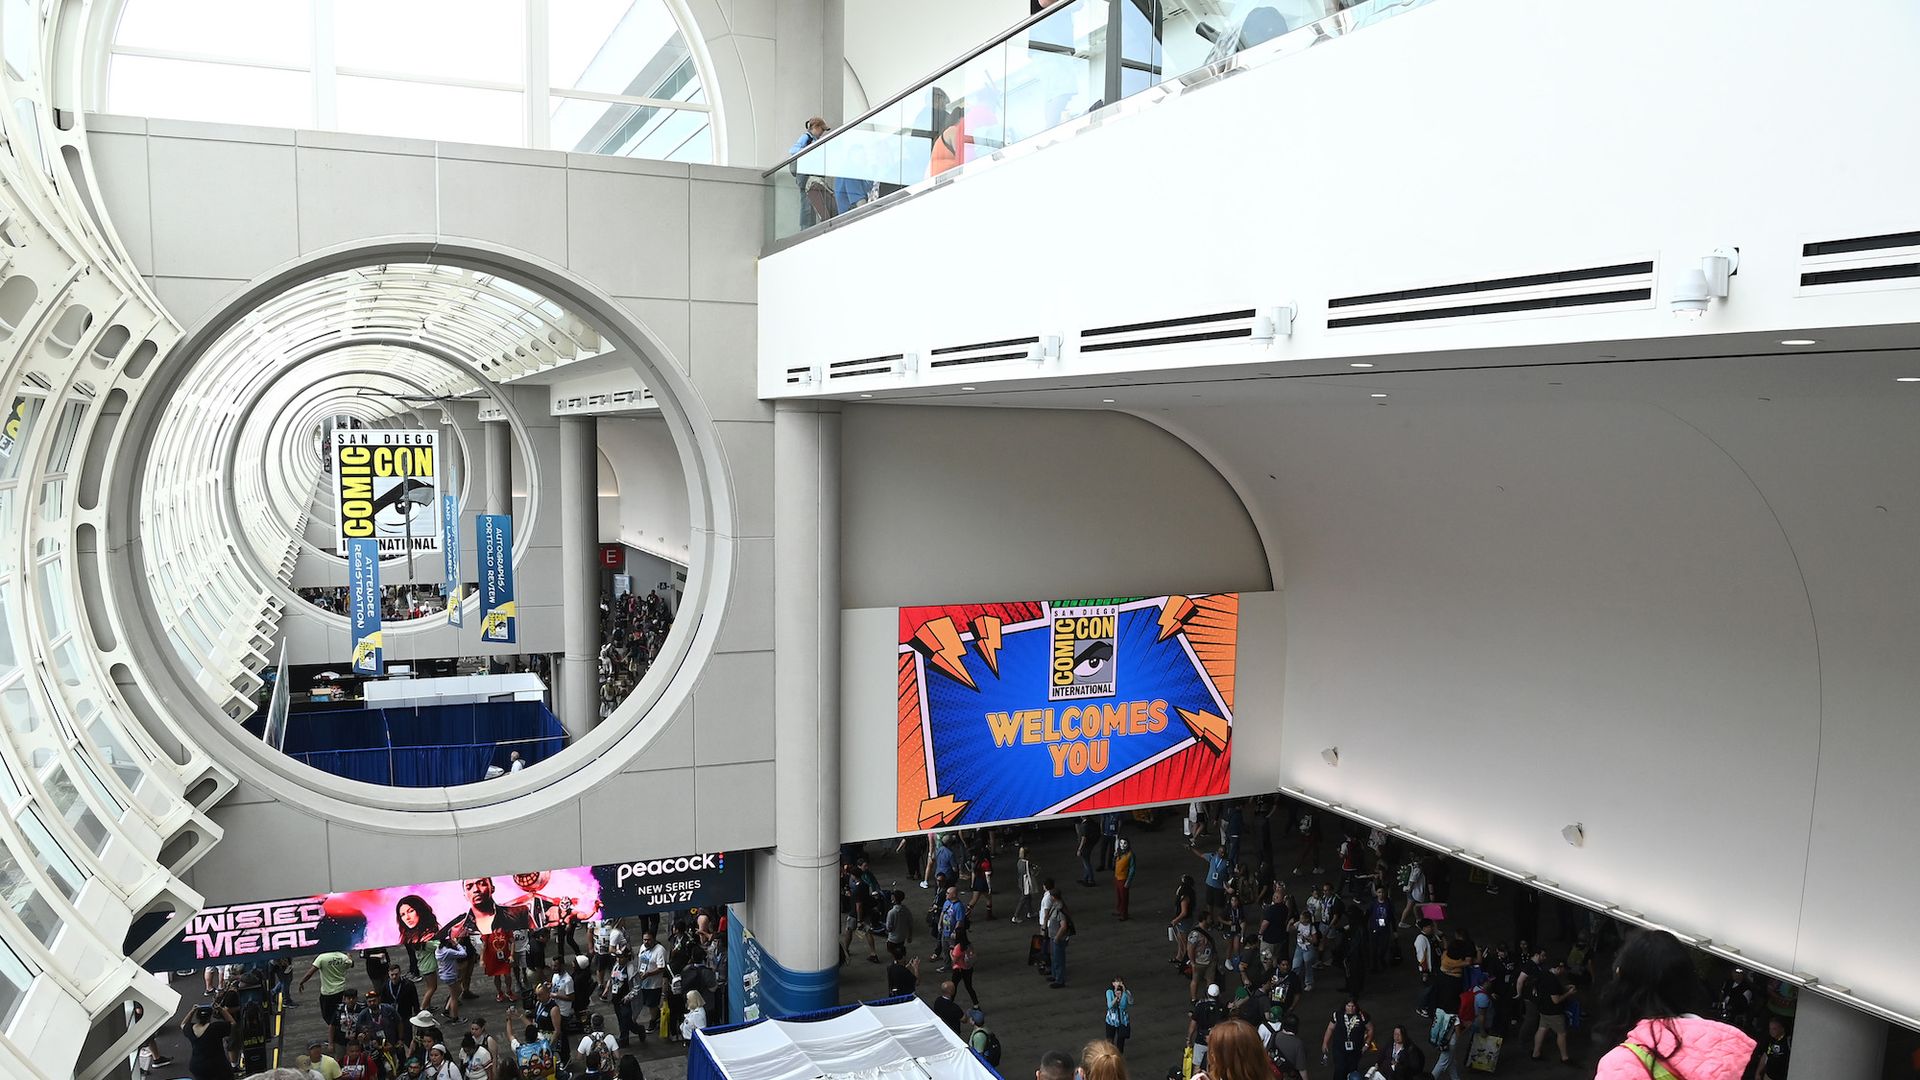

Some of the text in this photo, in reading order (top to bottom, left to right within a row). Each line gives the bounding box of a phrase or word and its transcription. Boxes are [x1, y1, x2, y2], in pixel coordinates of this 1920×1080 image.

[338, 434, 433, 444] SAN DIEGO
[373, 446, 434, 477] CON
[340, 446, 374, 537] COMIC
[485, 516, 496, 604] PORTFOLIO REVIEW
[606, 549, 617, 563] E
[354, 544, 365, 629] REGISTRATION
[365, 556, 375, 618] ATTENDEE
[1054, 607, 1116, 617] SAN DIEGO
[1075, 616, 1115, 640] CON
[1053, 618, 1076, 685] COMIC
[1052, 683, 1114, 697] INTERNATIONAL
[986, 699, 1168, 748] WELCOMES
[1048, 739, 1110, 777] YOU
[617, 853, 717, 888] peacock
[638, 879, 701, 896] NEW SERIES
[647, 890, 694, 906] JULY 27
